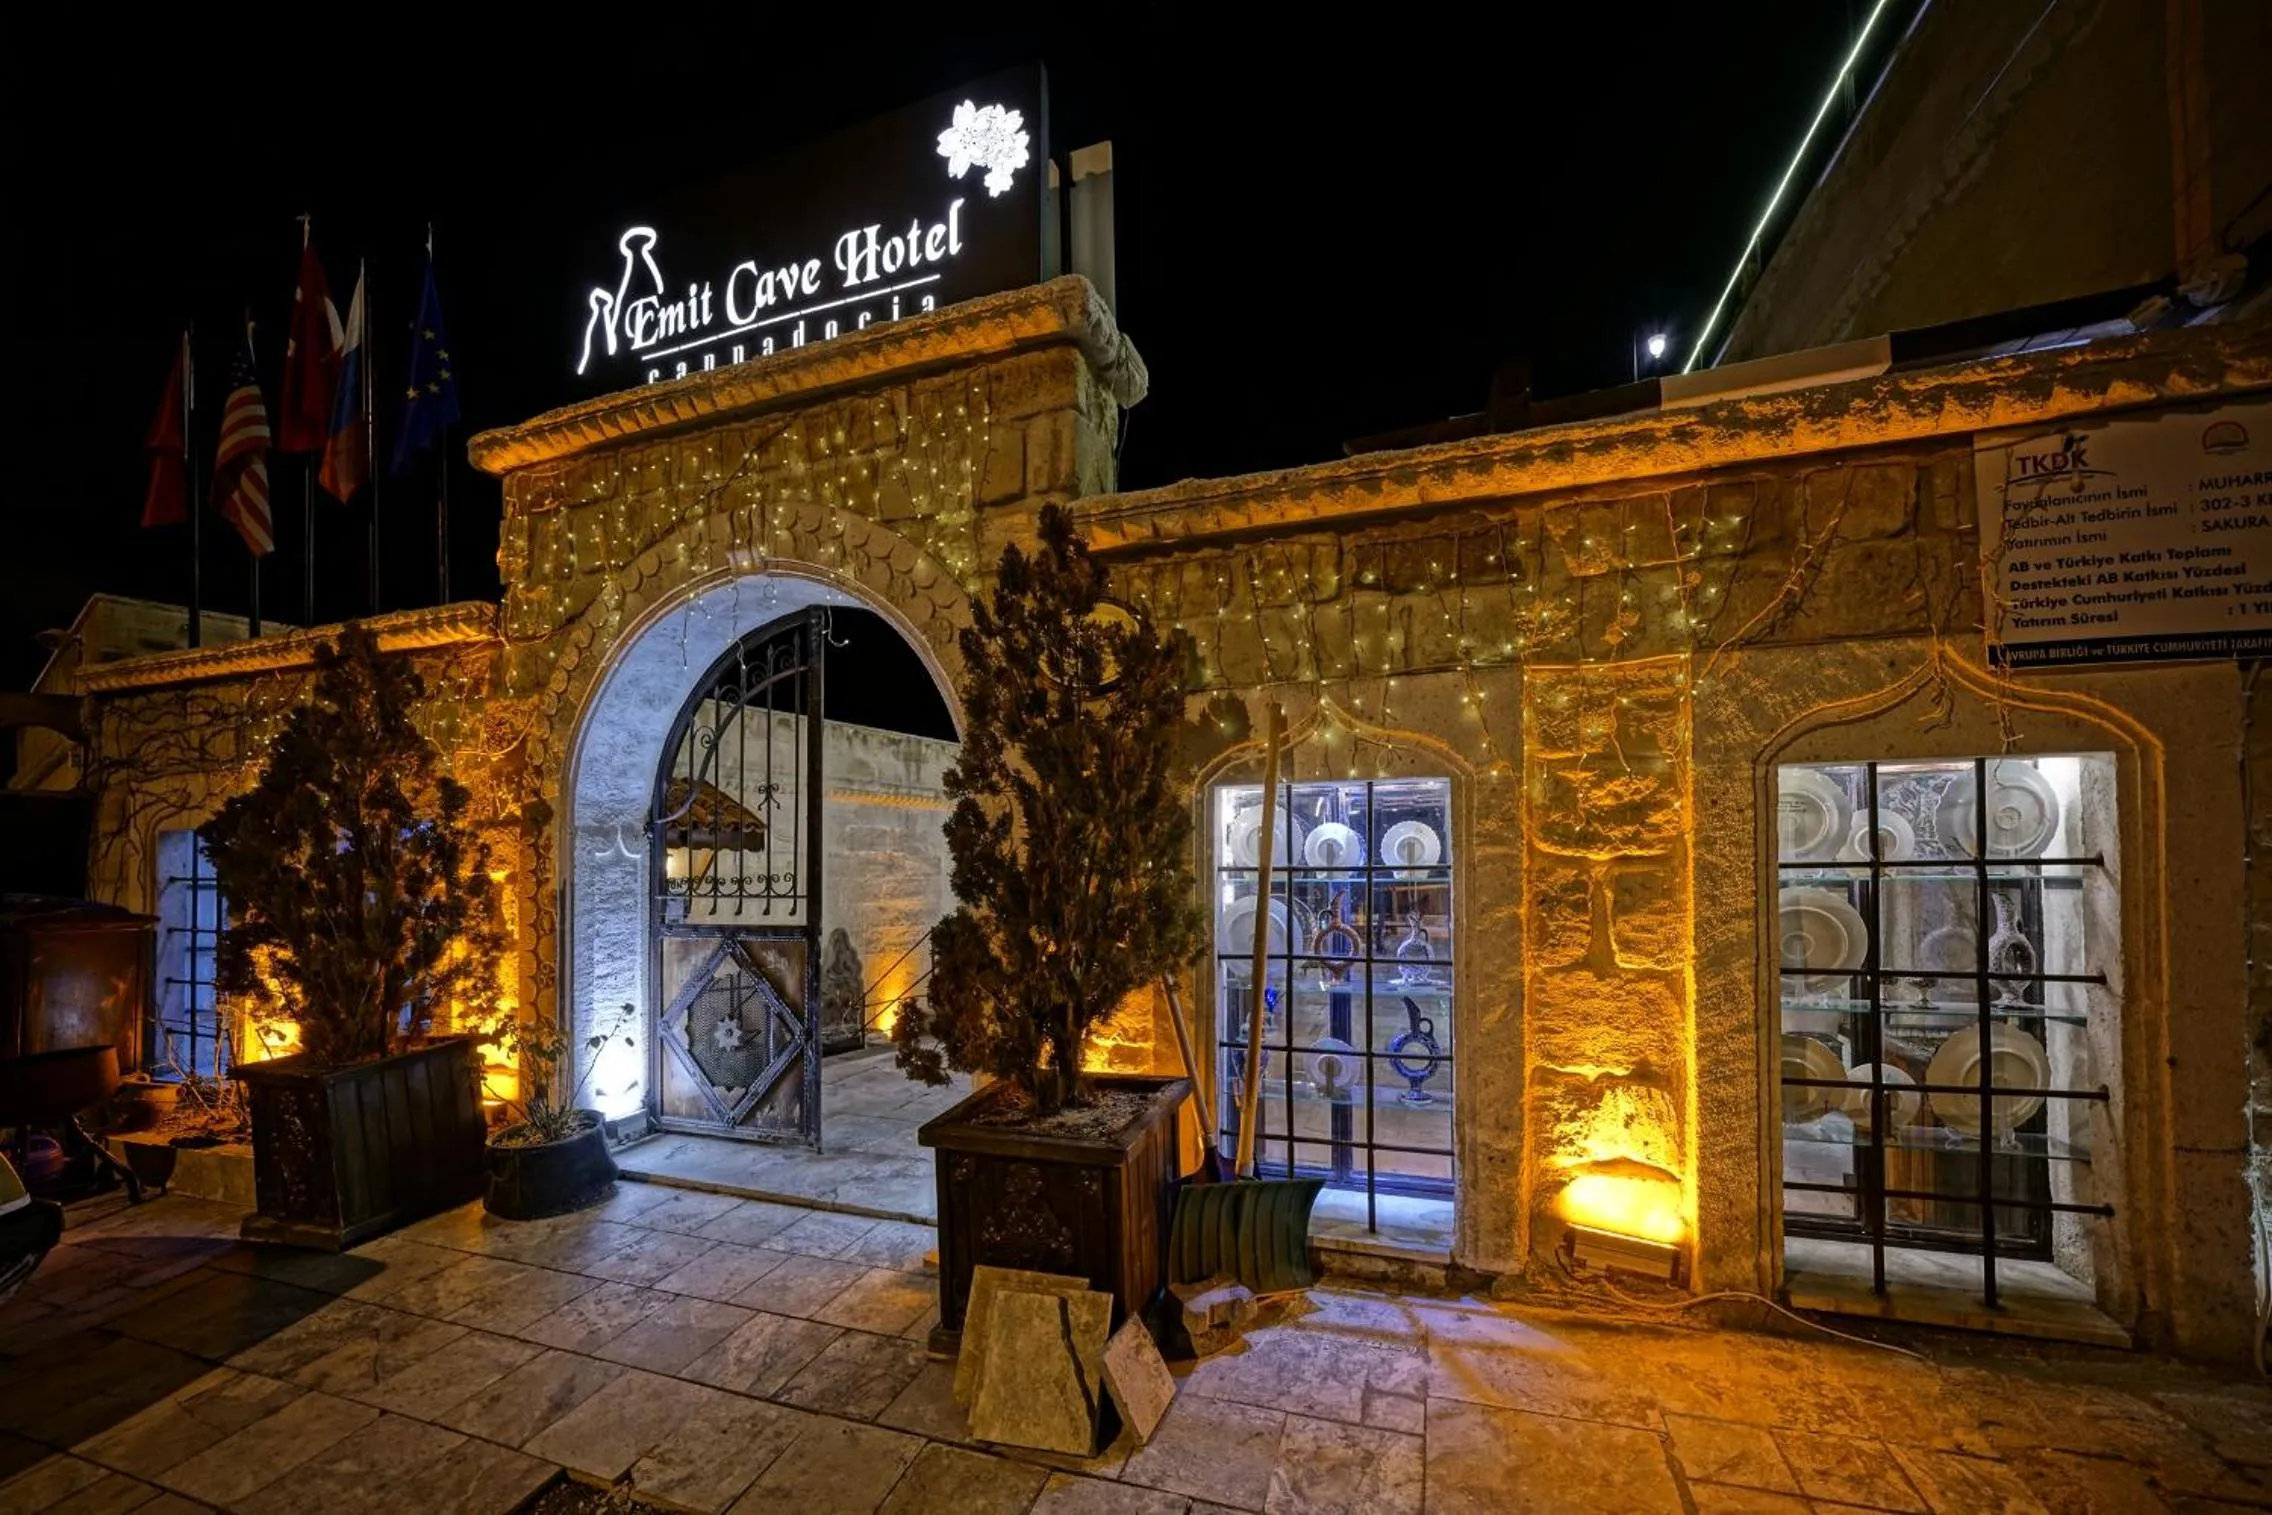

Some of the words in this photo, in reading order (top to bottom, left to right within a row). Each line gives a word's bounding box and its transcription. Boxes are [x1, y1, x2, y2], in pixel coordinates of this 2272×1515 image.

[624, 281, 713, 352] Emit
[726, 258, 822, 326] Cave
[835, 197, 964, 288] Hotel
[2016, 450, 2089, 475] TKDK
[2081, 506, 2141, 522] Tedbirin
[2201, 495, 2251, 512] 302-3
[2201, 515, 2270, 533] SAKURA
[2009, 561, 2029, 573] AB
[2034, 562, 2052, 571] ve
[2057, 554, 2114, 569] Türkiye
[2119, 549, 2162, 564] Katkı
[2166, 546, 2232, 561] Toplamı
[2010, 574, 2092, 592] Destekteki
[2096, 572, 2118, 584] AB
[2123, 568, 2178, 583] Katkısı
[2182, 562, 2246, 579] Yüzdesi
[2011, 597, 2068, 611] Türkiye
[2072, 588, 2167, 605] Cumhuriyeti
[2172, 585, 2228, 600] Katkısı
[2011, 618, 2066, 629] Yatırım
[2070, 609, 2118, 625] Süresi
